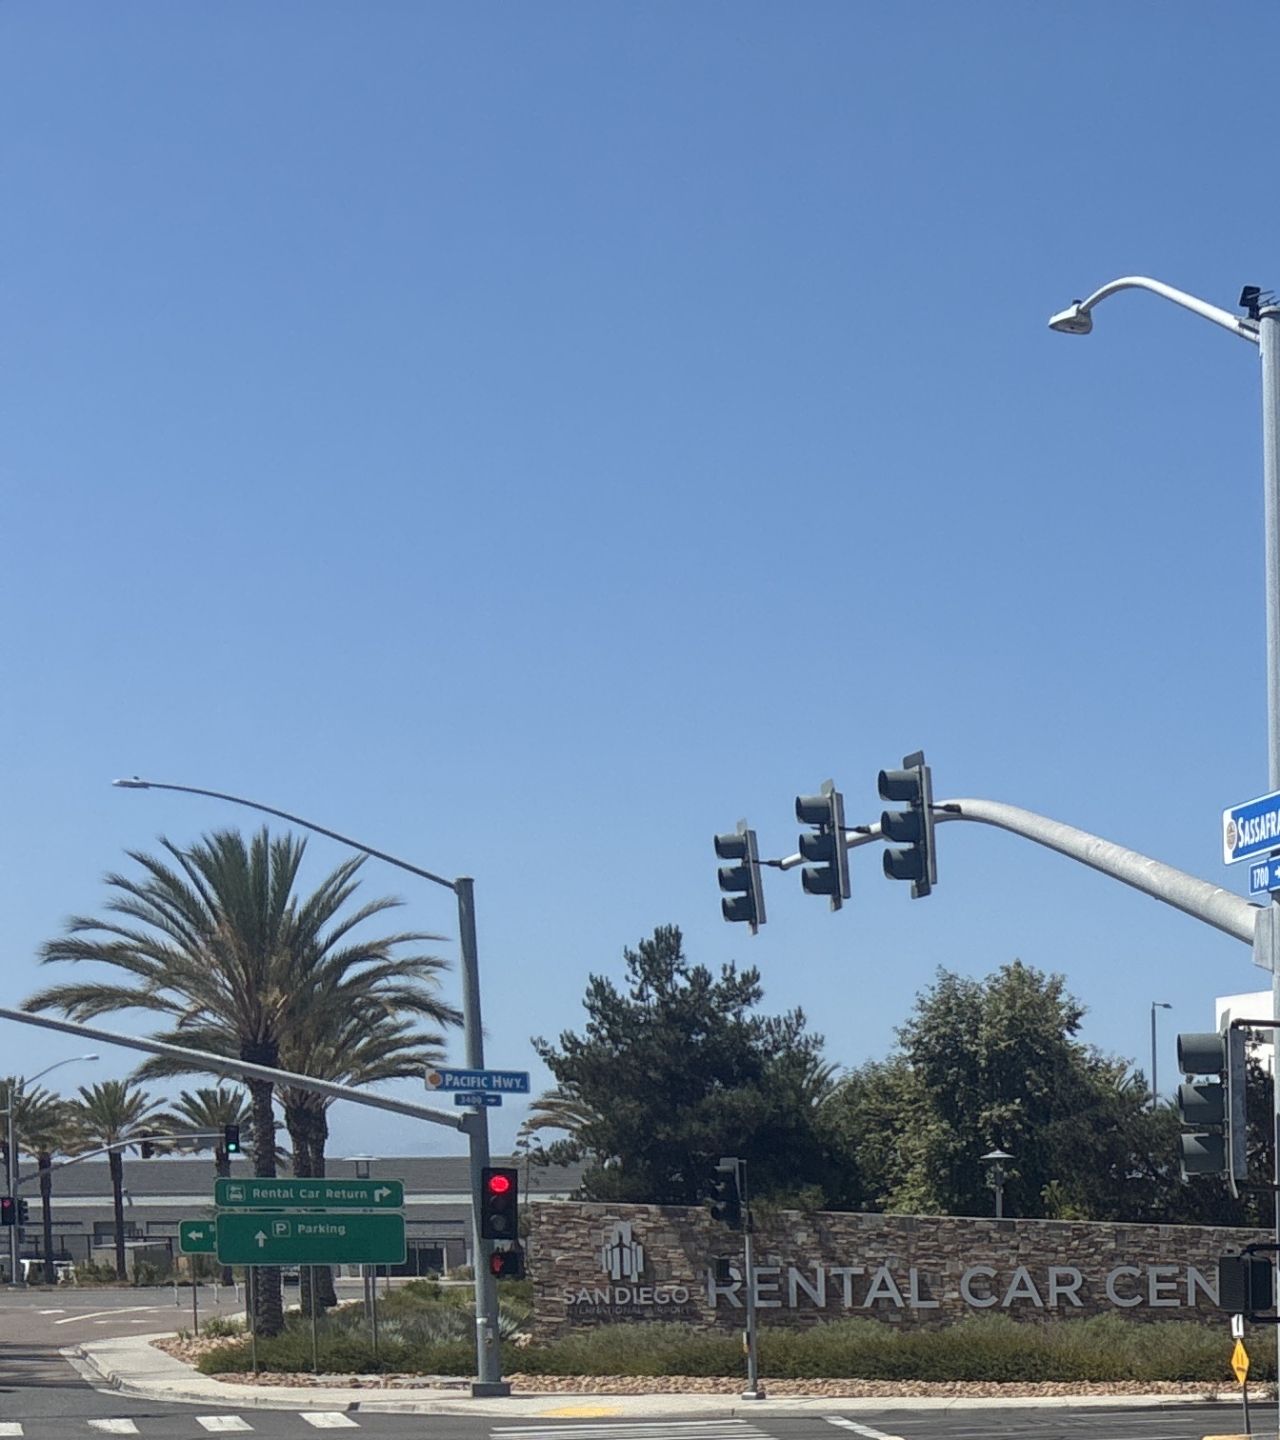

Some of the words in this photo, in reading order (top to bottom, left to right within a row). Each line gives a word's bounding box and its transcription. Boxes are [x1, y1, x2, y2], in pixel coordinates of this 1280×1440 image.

[1253, 866, 1269, 889] 1700
[445, 1074, 487, 1088] PACIFIC
[252, 1188, 294, 1199] Rental
[299, 1188, 322, 1199] Car
[326, 1188, 368, 1200] Return
[297, 1224, 346, 1236] Parking
[708, 1265, 940, 1308] RENTAL
[960, 1264, 1084, 1308] CAR
[563, 1286, 610, 1306] SAN
[614, 1286, 690, 1305] DIEGO
